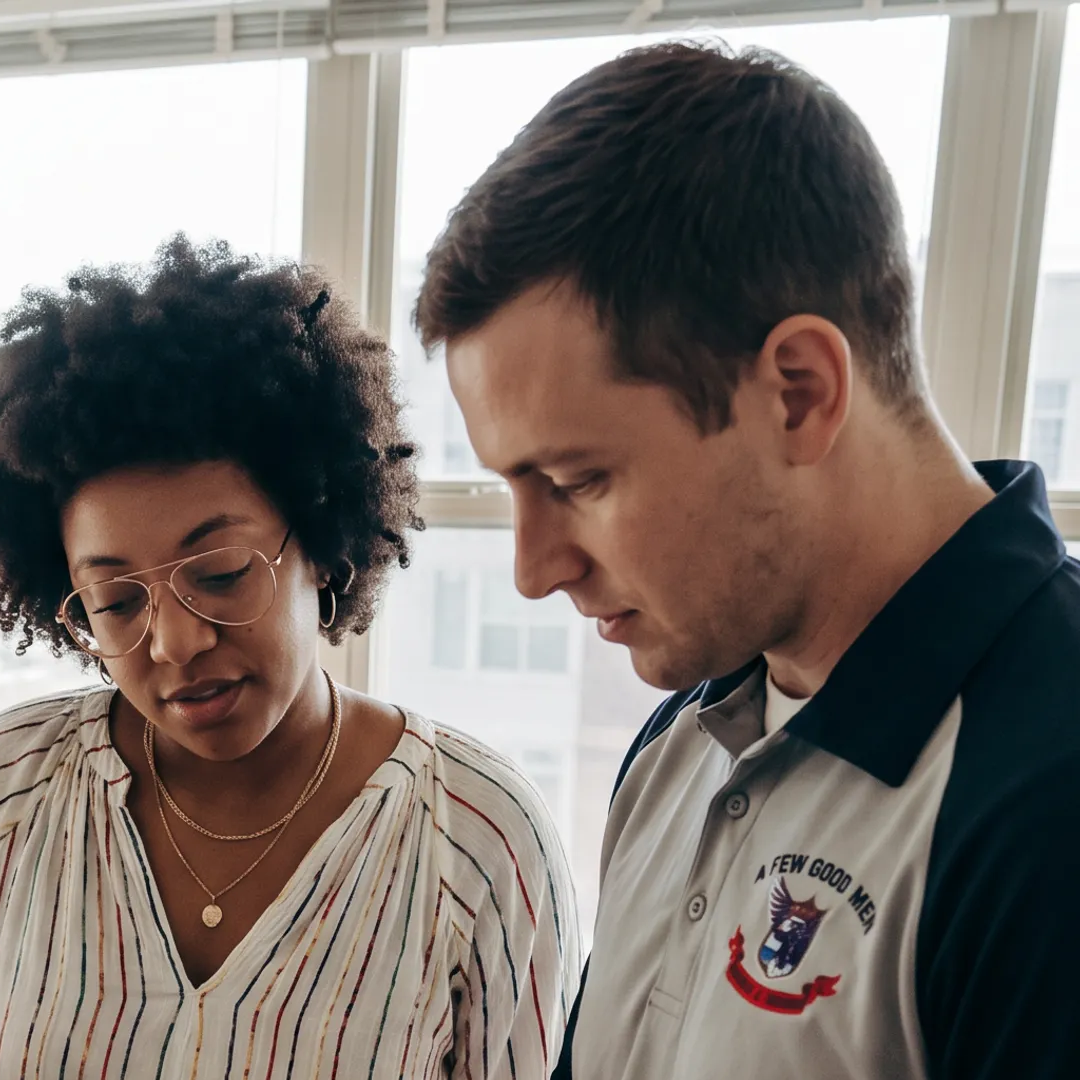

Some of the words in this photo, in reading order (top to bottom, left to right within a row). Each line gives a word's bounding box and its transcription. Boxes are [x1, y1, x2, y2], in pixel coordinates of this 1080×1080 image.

[754, 864, 766, 885] A
[769, 854, 810, 876] FEW
[808, 858, 853, 894] GOOD
